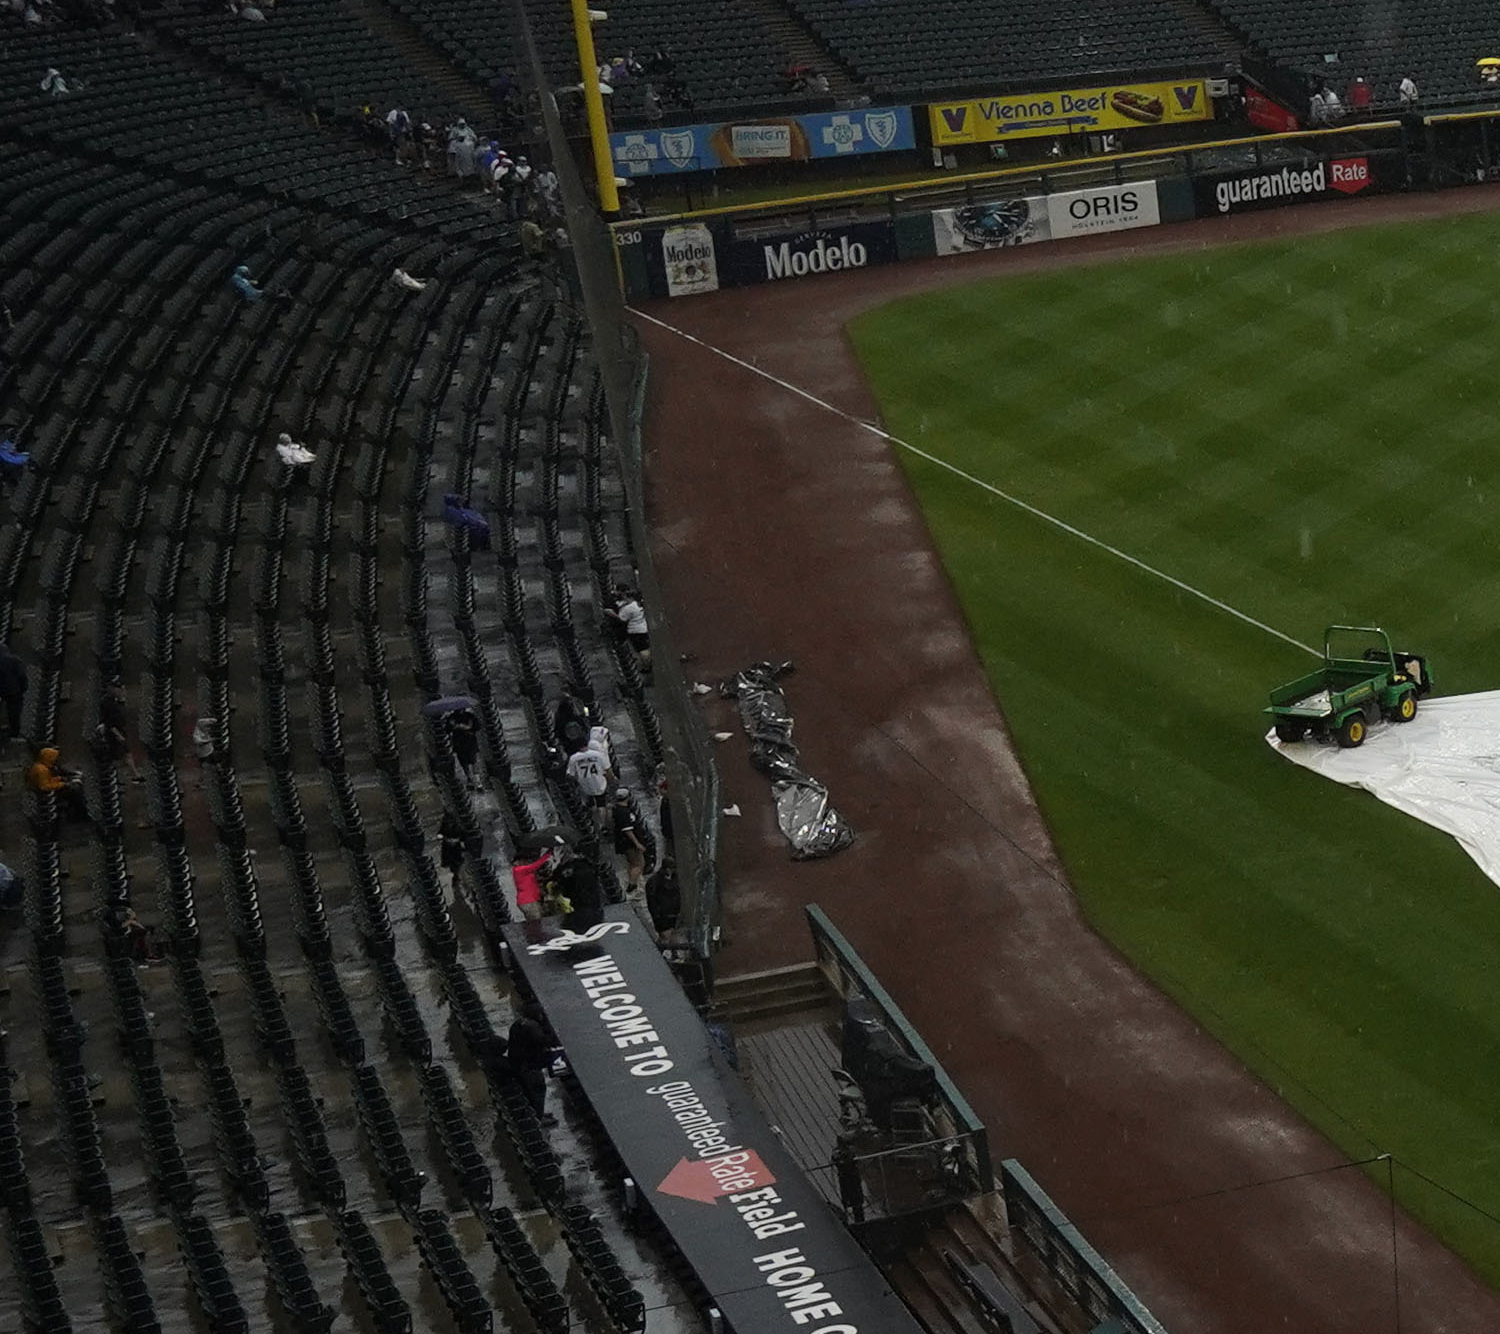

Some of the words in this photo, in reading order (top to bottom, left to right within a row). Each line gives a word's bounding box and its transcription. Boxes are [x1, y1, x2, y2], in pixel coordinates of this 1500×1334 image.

[978, 98, 1055, 122] Vienna
[1061, 90, 1109, 114] Beef
[1069, 191, 1140, 221] ORIS
[1215, 164, 1326, 213] guaranteed
[1331, 162, 1368, 185] Rate
[616, 231, 643, 247] 330
[763, 235, 868, 282] Modelo
[573, 954, 660, 1049] WELCOME
[624, 1045, 675, 1077] TO
[752, 1247, 843, 1326] HOME
